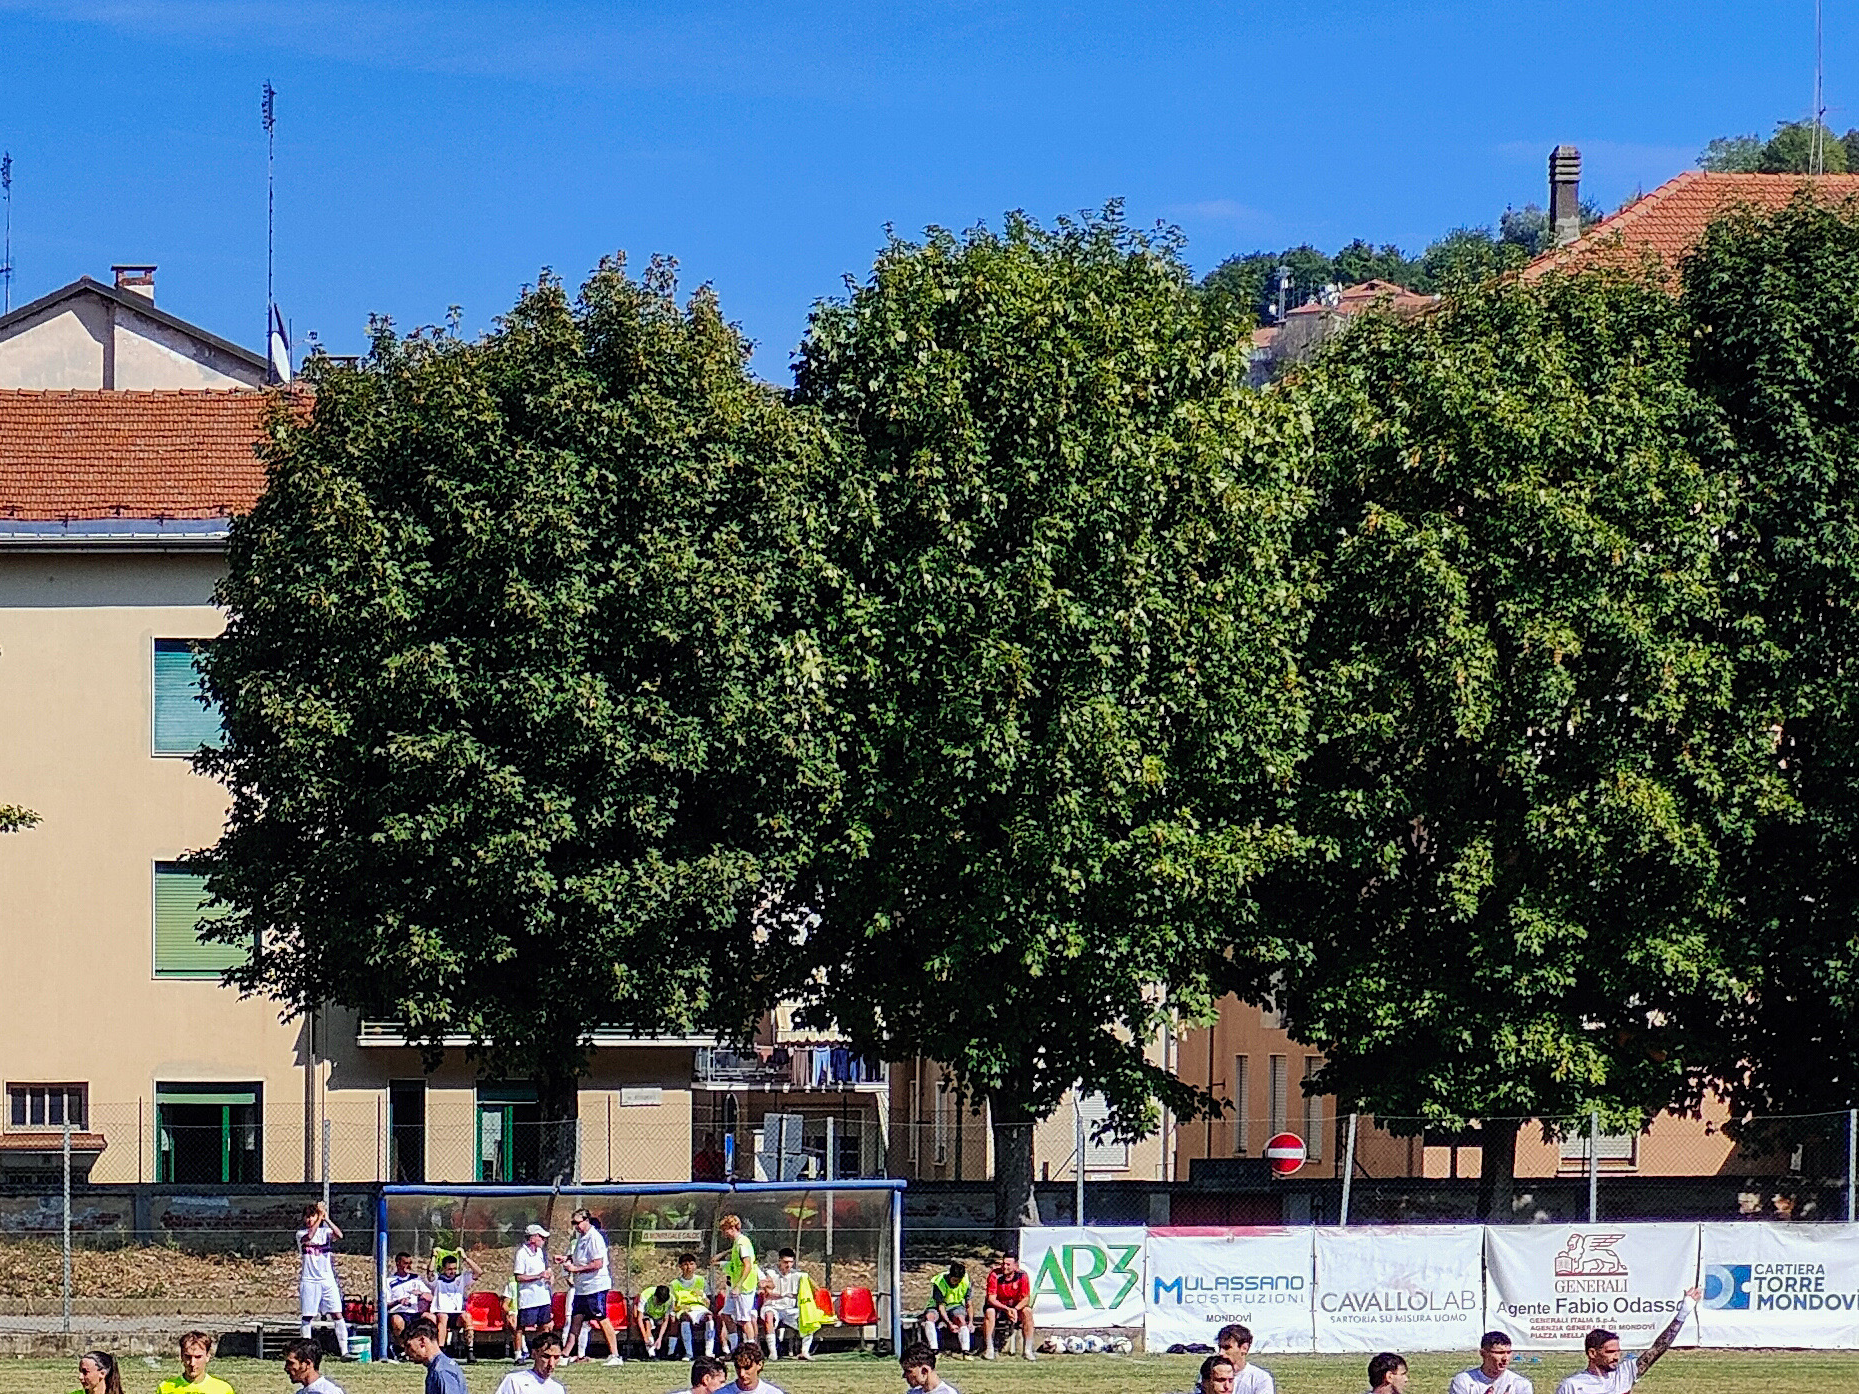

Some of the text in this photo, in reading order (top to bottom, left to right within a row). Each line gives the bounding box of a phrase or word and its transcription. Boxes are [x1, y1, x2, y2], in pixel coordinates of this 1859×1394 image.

[1754, 1263, 1825, 1275] CARTIERA
[1030, 1245, 1142, 1310] AR3
[1754, 1277, 1825, 1292] TORRE
[1153, 1276, 1304, 1305] MULASSANO
[1554, 1279, 1628, 1293] GENERALI
[1185, 1294, 1305, 1304] COSTRUZIONI
[1320, 1290, 1476, 1312] CAVALLOLAB
[1496, 1302, 1551, 1317] Agente
[1555, 1297, 1609, 1314] Fabio
[1206, 1312, 1252, 1322] MONDOVÌ
[1330, 1313, 1467, 1323] SARTORIA SU MISURA UOMO
